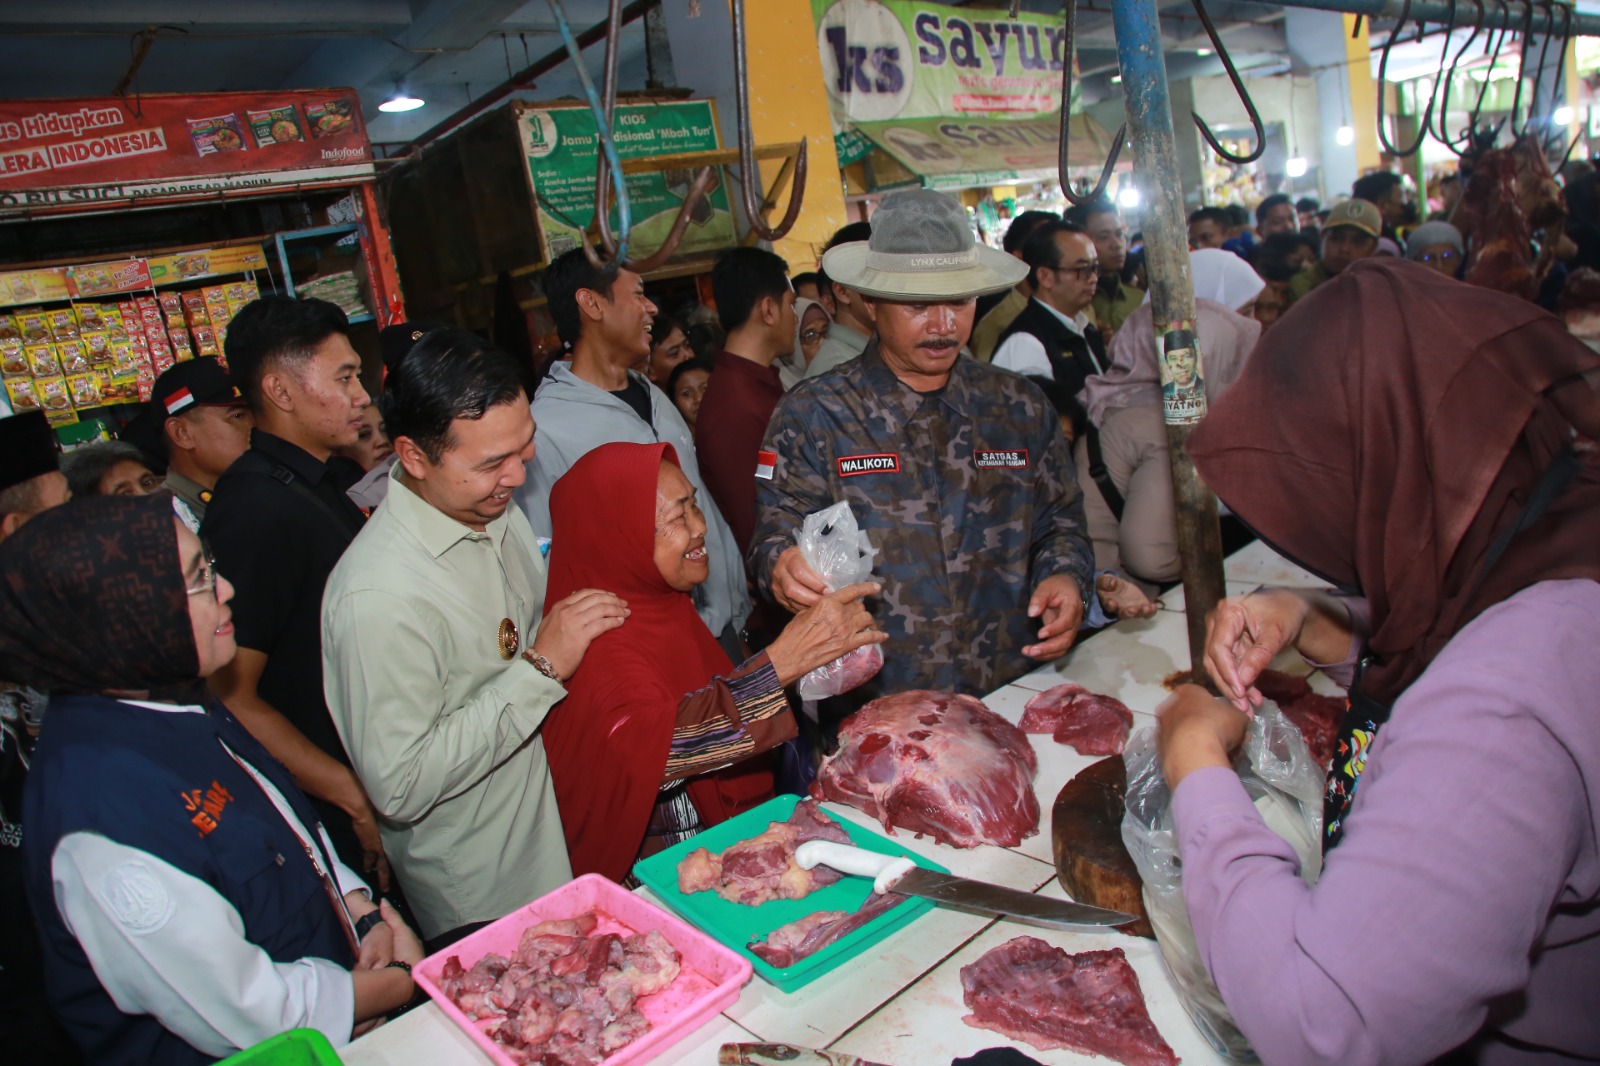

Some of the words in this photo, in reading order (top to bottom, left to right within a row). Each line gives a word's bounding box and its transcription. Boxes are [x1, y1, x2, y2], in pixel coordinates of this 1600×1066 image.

[23, 108, 123, 137] Hidupkan
[619, 114, 647, 126] KIOS
[561, 135, 593, 146] Jamu
[594, 129, 656, 144] Tdisional
[51, 131, 164, 165] INDONESIA
[321, 145, 365, 160] Indofood
[982, 452, 1018, 461] SATGAS
[841, 457, 895, 472] WALIKOTA
